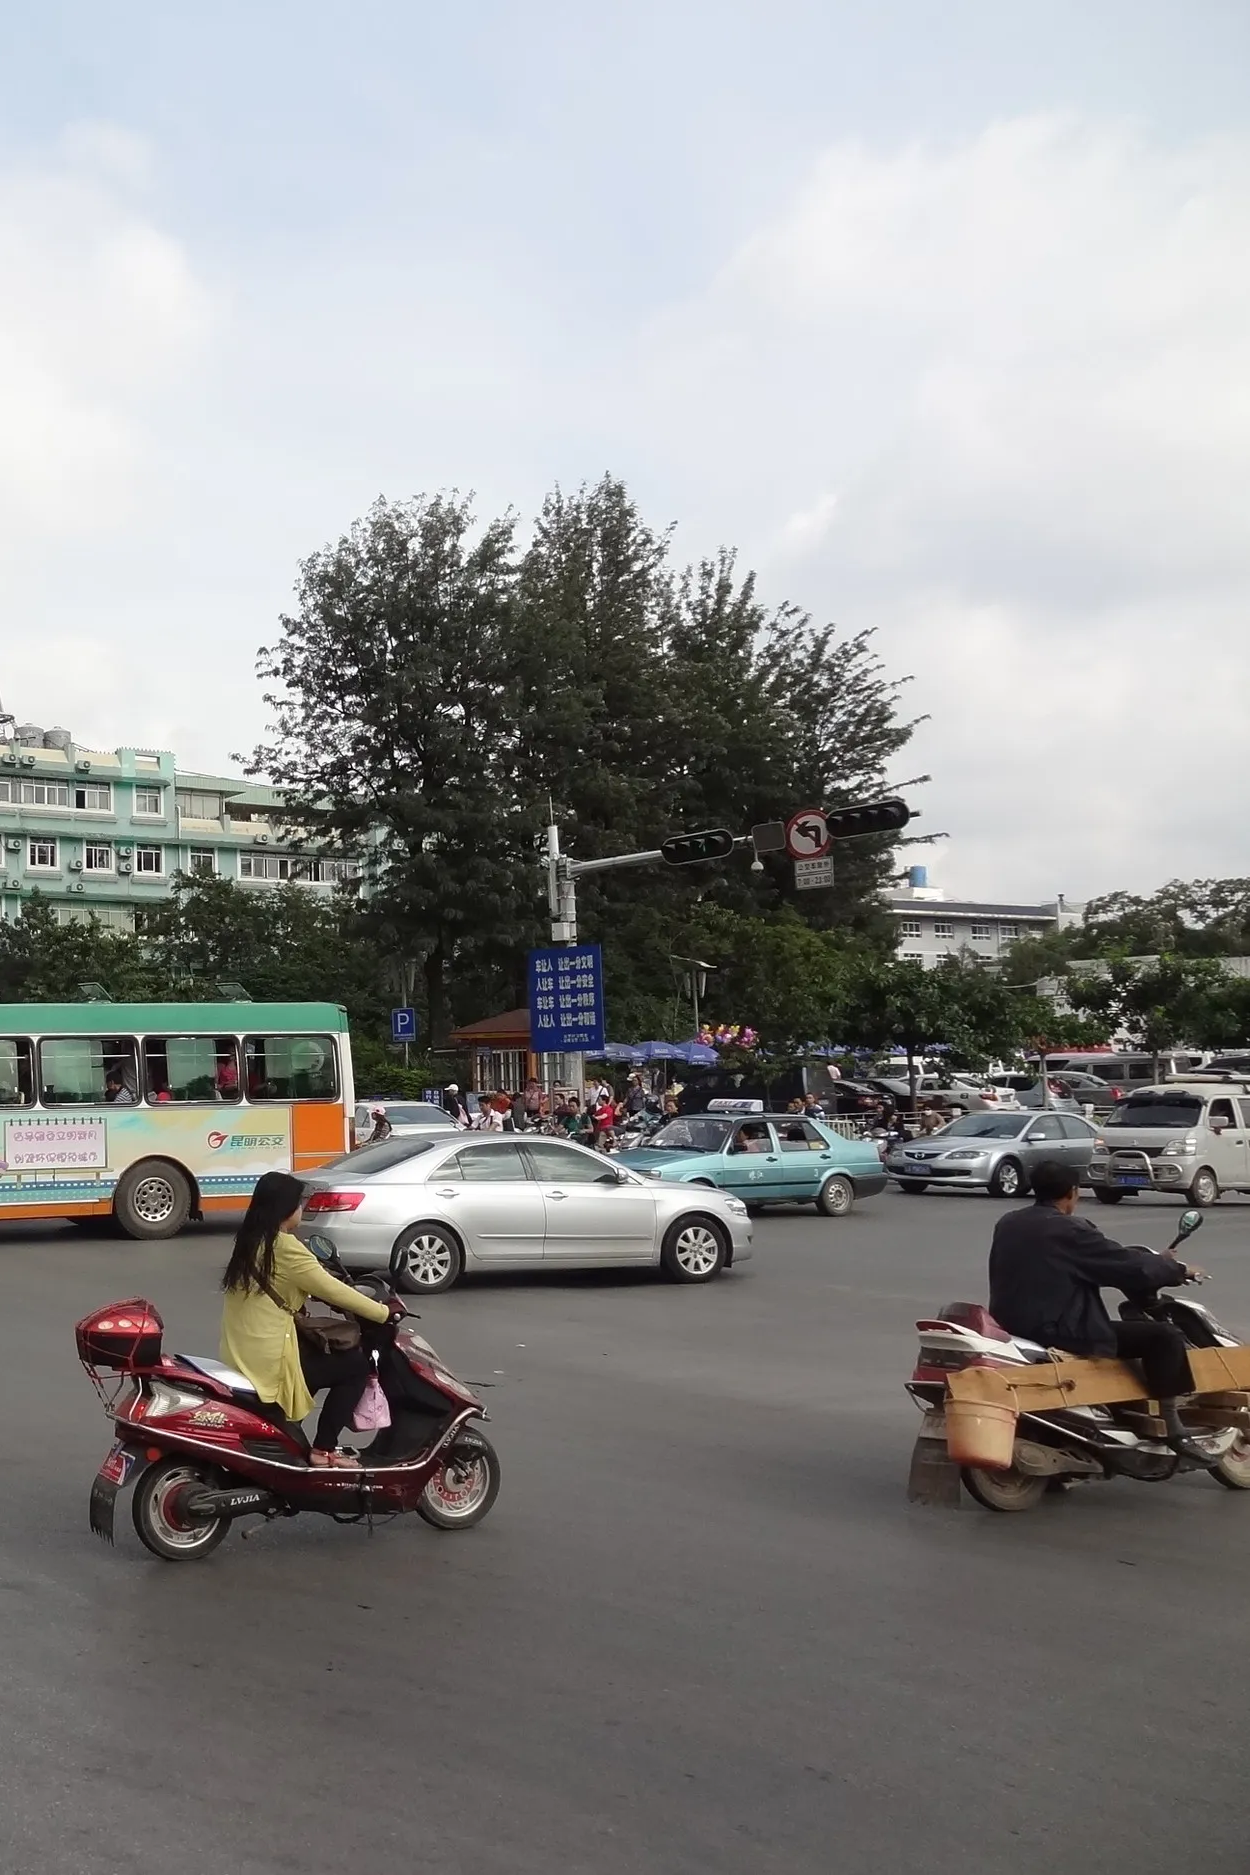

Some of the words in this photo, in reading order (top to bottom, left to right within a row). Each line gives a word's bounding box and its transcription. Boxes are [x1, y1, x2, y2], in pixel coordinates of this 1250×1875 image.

[230, 1135, 285, 1147] 昆明公交
[230, 1494, 261, 1506] LVJIA
